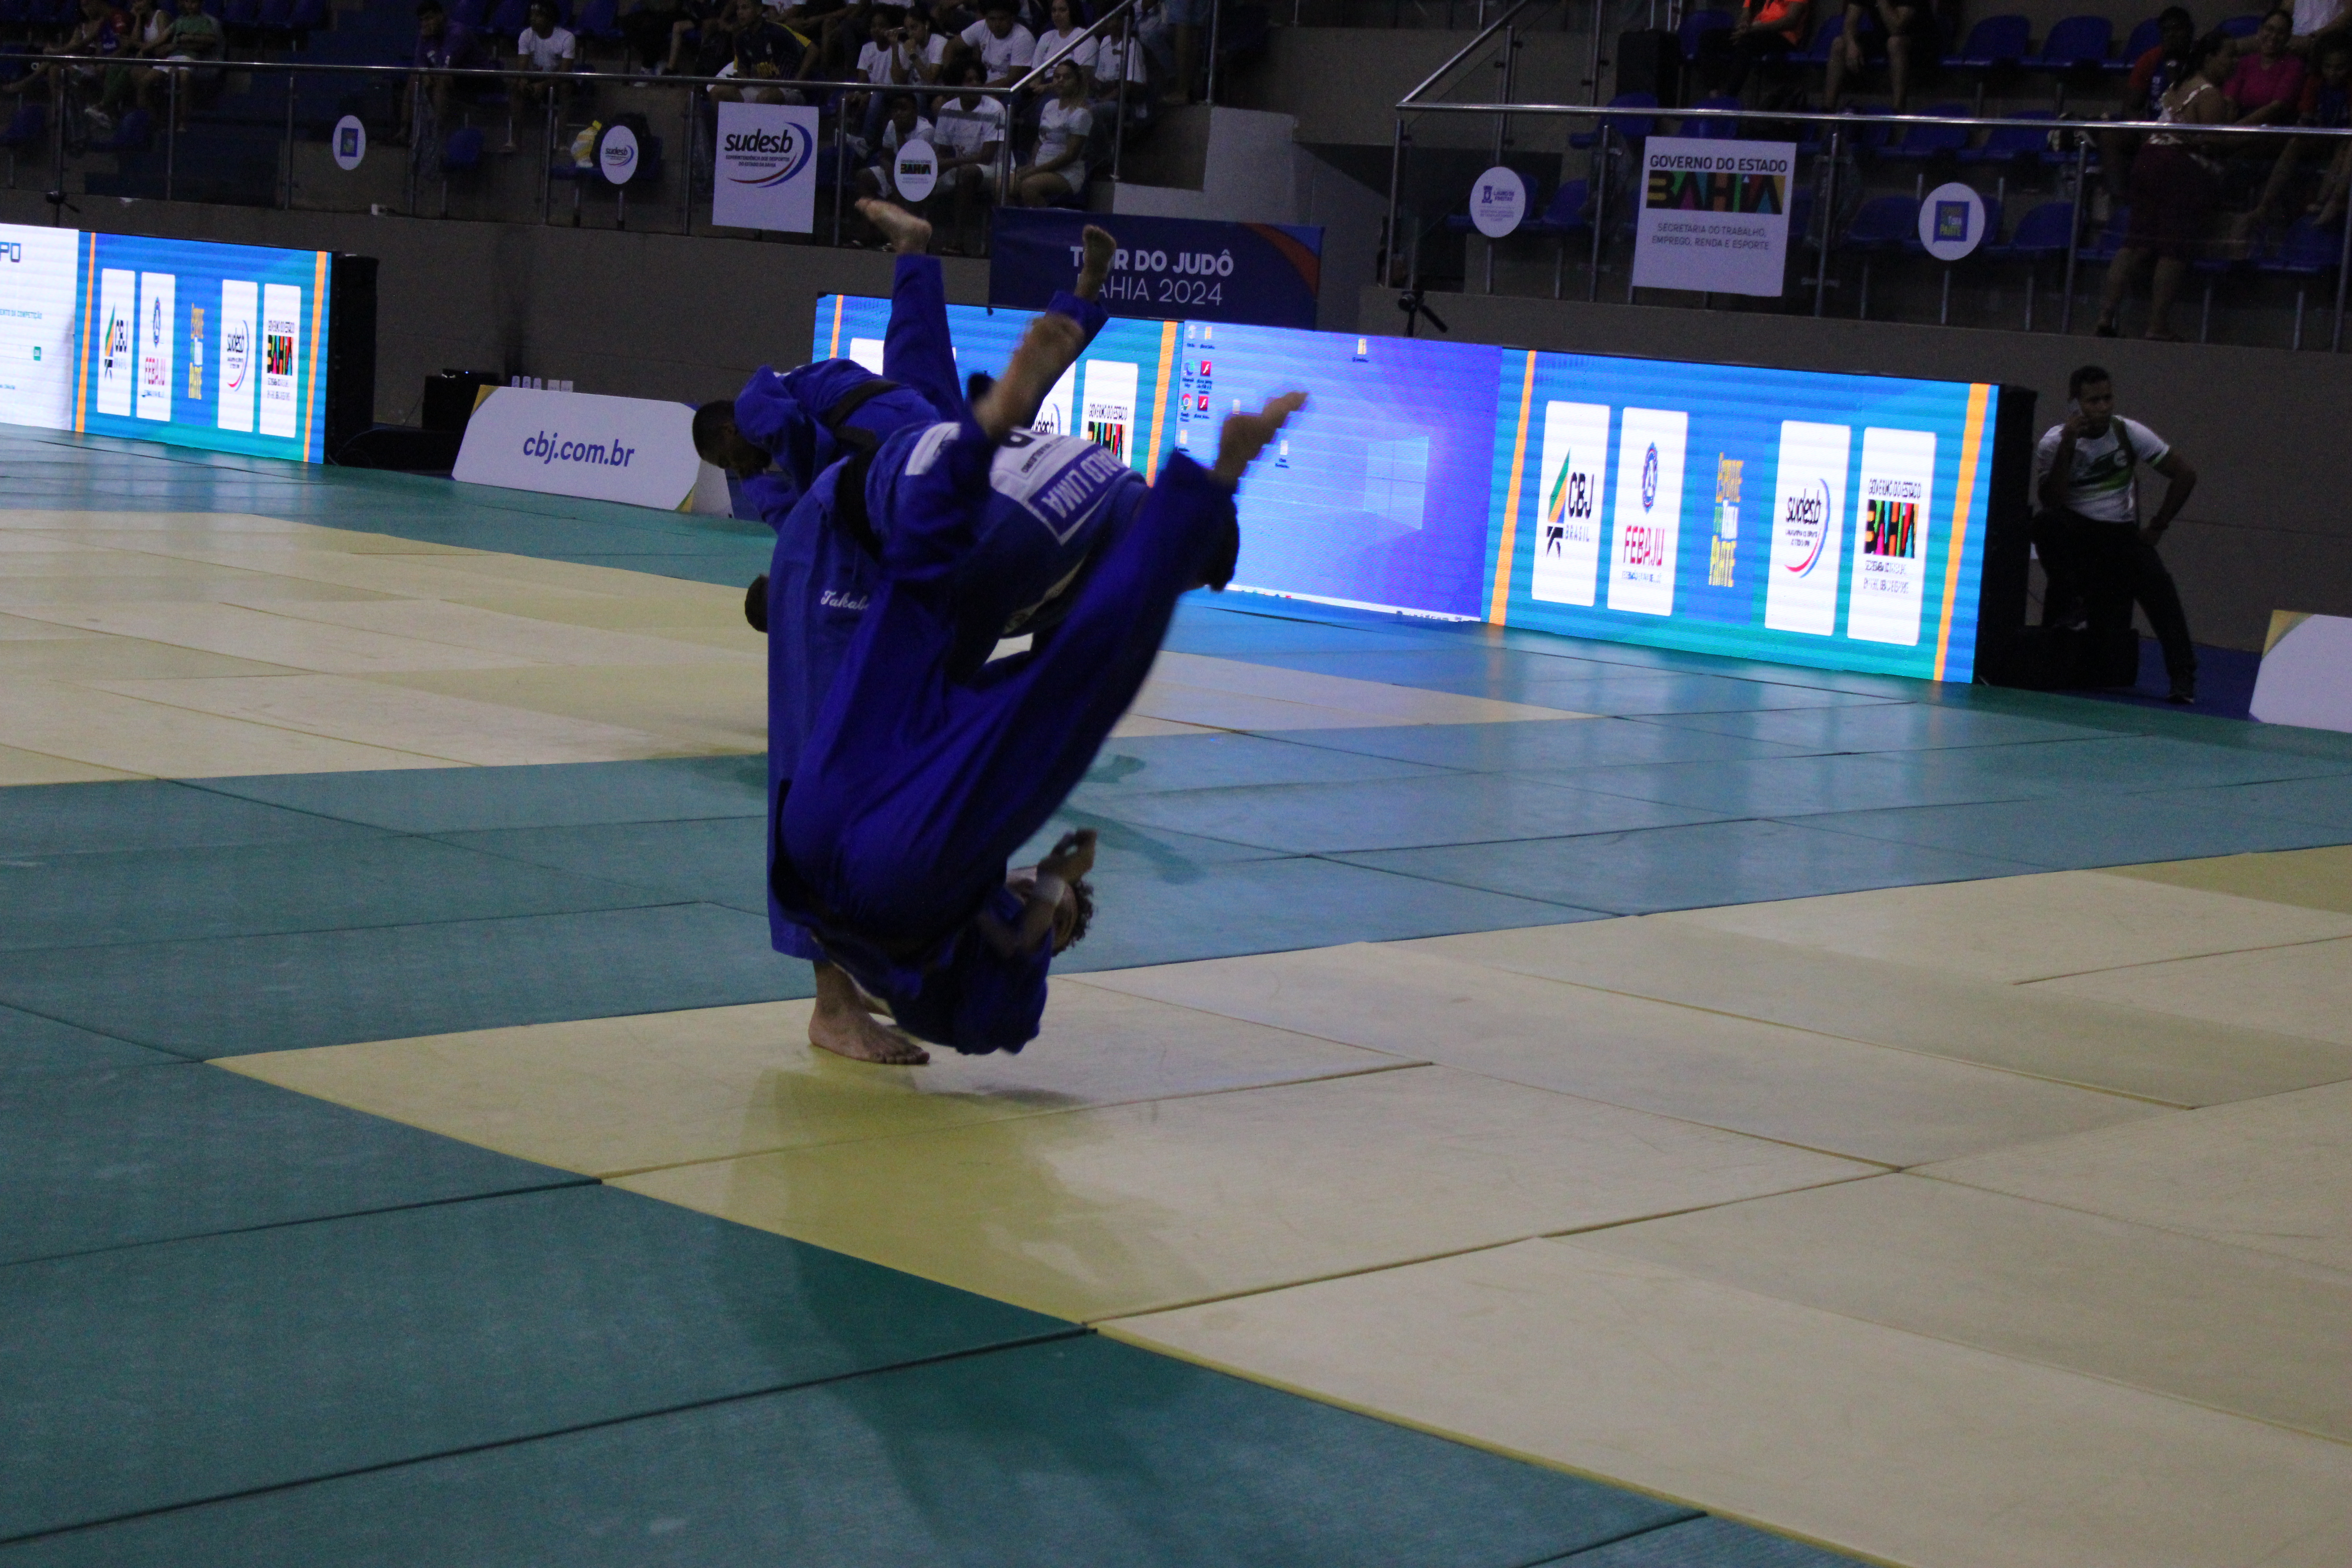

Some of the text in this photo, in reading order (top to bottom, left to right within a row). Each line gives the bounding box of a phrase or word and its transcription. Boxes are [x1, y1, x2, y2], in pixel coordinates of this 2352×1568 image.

[605, 147, 628, 156] sudesb
[724, 129, 793, 153] sudesb
[900, 163, 931, 174] BAHIA
[1650, 156, 1787, 172] GOVERNO DO ESTADO
[1646, 169, 1786, 215] BAHIA
[1652, 236, 1769, 250] EMPREGO, RENDA E ESPORTE
[1658, 223, 1766, 238] SECRETARIA DO TRABALHO,
[1070, 246, 1234, 276] TR DO JUDÔ
[1159, 279, 1222, 306] 2024
[116, 319, 128, 353] CBJ
[523, 431, 635, 467] cbj.com.br
[1041, 469, 1094, 518] LIMA
[1568, 472, 1594, 519] CBJ
[1786, 488, 1821, 524] sudesb
[1565, 524, 1589, 542] BRASIL
[1863, 499, 1919, 559] BAHIA
[1623, 525, 1664, 566] FEBAJU
